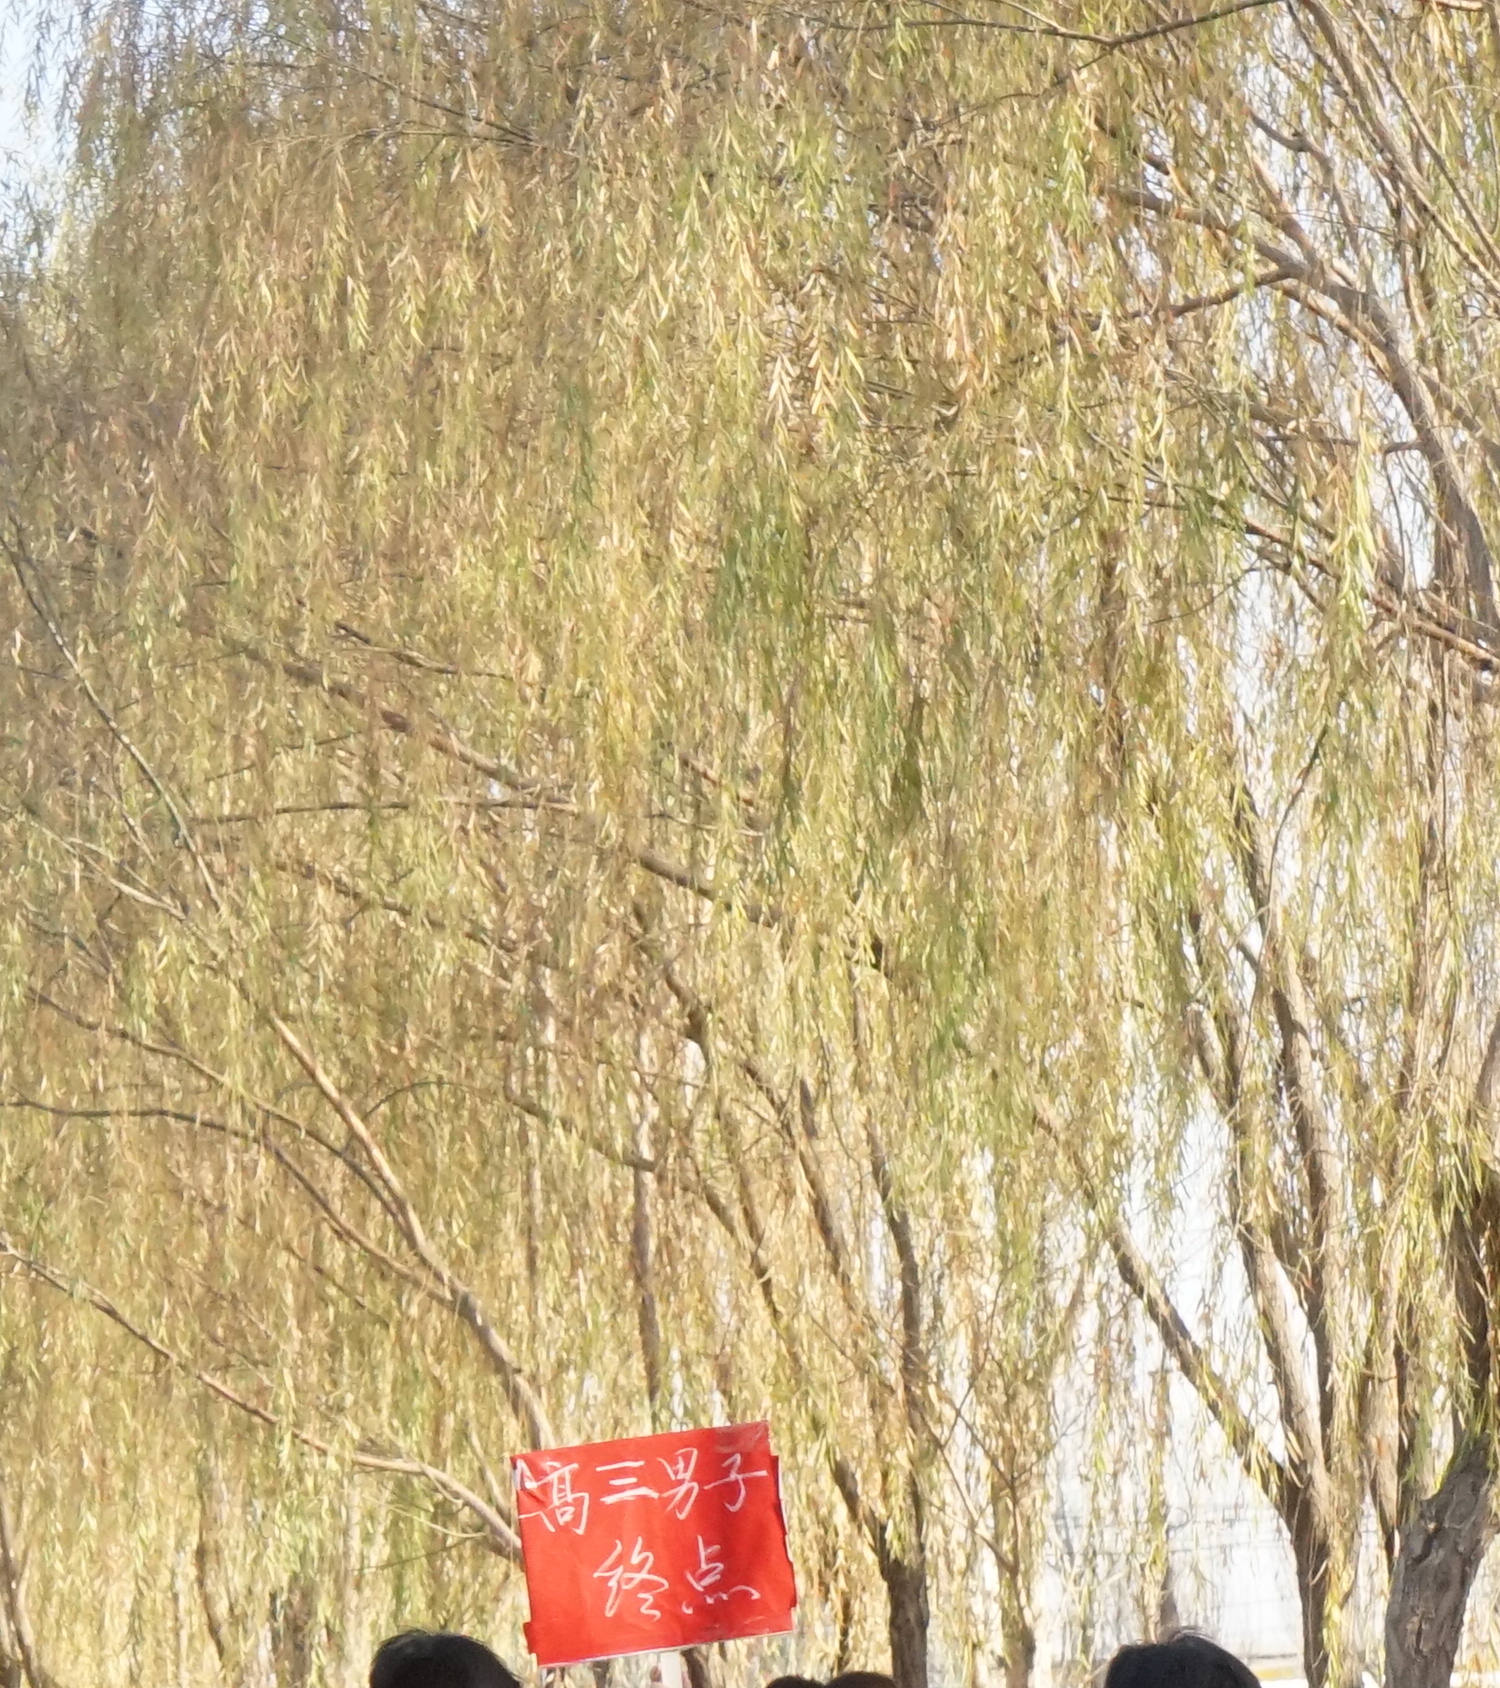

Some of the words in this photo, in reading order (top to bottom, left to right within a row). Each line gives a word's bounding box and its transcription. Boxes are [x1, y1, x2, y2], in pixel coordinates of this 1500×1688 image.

[517, 1447, 769, 1536] 高三男子
[593, 1535, 761, 1622] 终点
